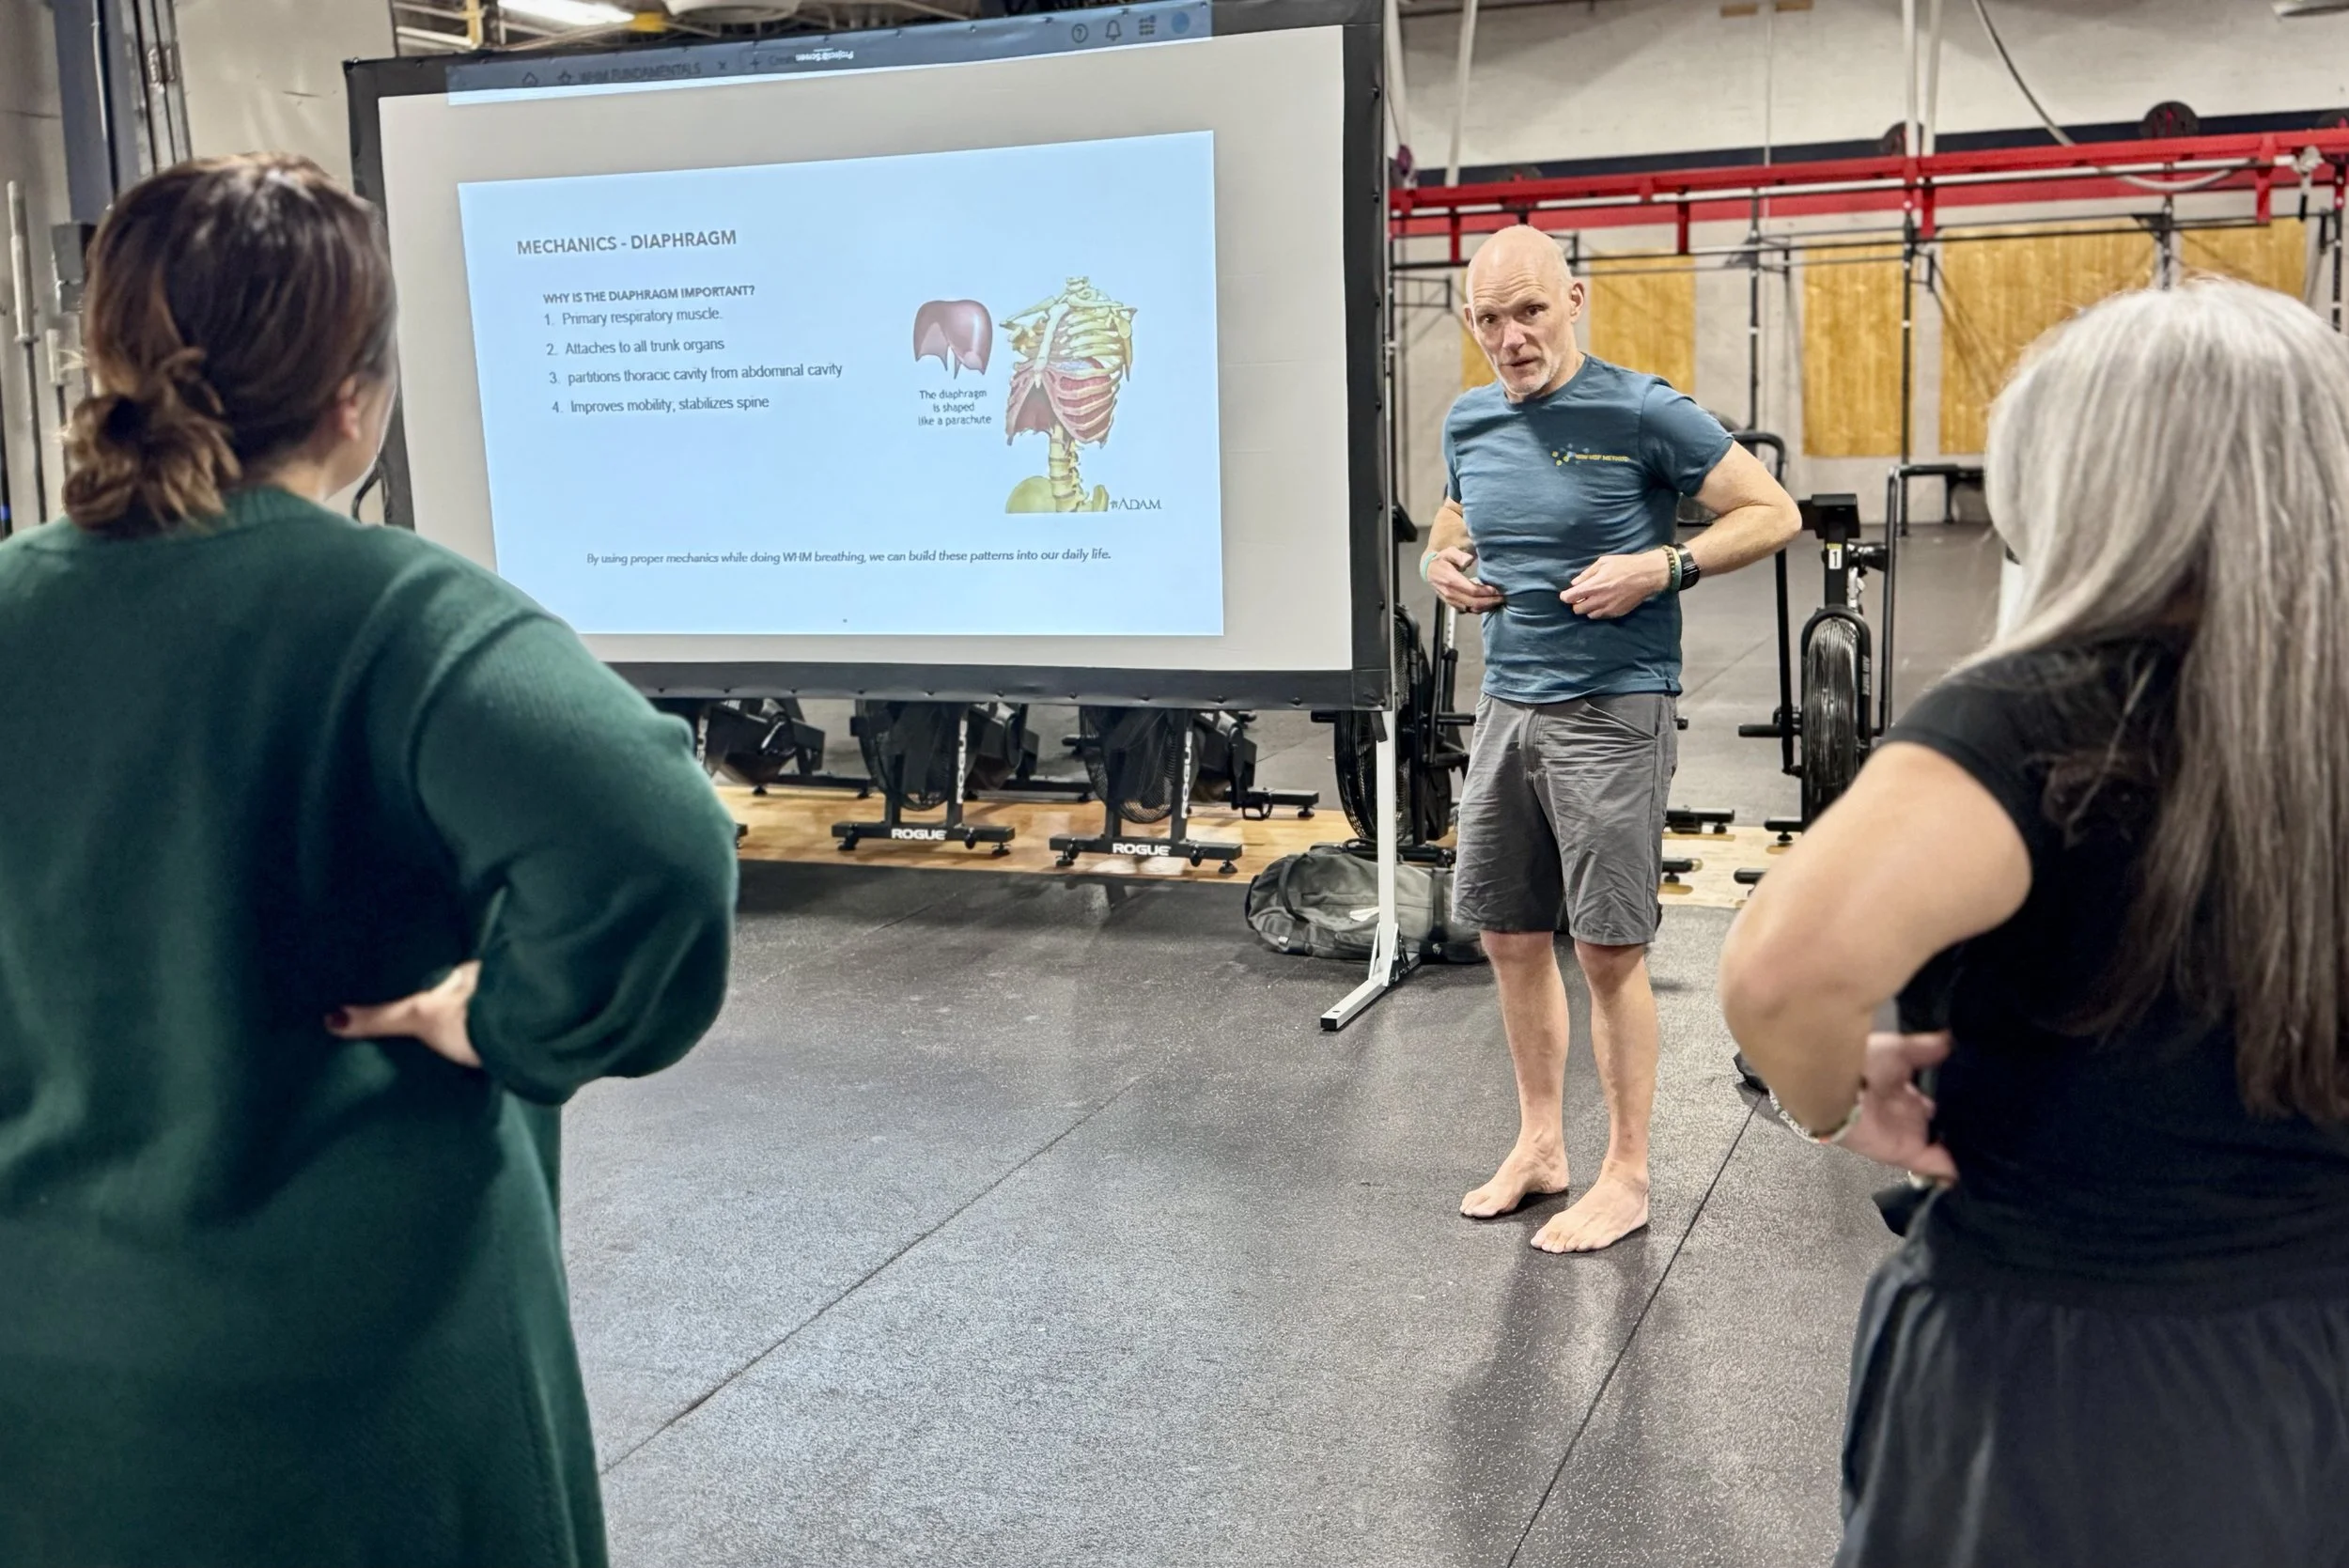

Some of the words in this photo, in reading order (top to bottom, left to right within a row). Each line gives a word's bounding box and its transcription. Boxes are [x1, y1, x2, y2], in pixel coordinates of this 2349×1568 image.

[517, 235, 617, 256] MECHANICS
[630, 229, 737, 250] DIAPHRAGM
[542, 292, 570, 304] WHY
[571, 292, 583, 303] IS
[583, 290, 607, 303] THE
[608, 287, 679, 302] DIAPHRAGM
[680, 285, 755, 299] IMPORTANT?
[562, 312, 608, 328] Primary
[610, 309, 674, 326] respiratory
[676, 306, 723, 321] muscle.
[545, 342, 558, 356] 2.
[565, 341, 616, 355] Attaches
[618, 340, 631, 354] to
[632, 339, 648, 353] all
[649, 338, 681, 353] trunk
[682, 339, 725, 354] organs
[568, 370, 622, 387] partitions
[623, 368, 671, 382] thoracic
[673, 366, 708, 383] cavity
[710, 365, 739, 380] from
[740, 363, 804, 379] abdominal
[806, 362, 843, 379] cavity
[918, 389, 938, 400] The
[938, 388, 988, 401] diaphragm
[570, 399, 625, 416] Improves
[677, 396, 735, 411] stabilizes
[736, 395, 770, 411] spine
[932, 402, 941, 413] is
[941, 400, 975, 414] shaped
[917, 414, 935, 427] like
[937, 416, 943, 426] a
[944, 414, 992, 427] parachute
[586, 552, 599, 567] By
[600, 553, 629, 567] using
[630, 554, 664, 567] proper
[665, 551, 720, 564] mechanics
[721, 551, 749, 563] while
[749, 551, 782, 566] doing
[782, 551, 813, 563] WHM
[814, 550, 867, 565] breathing,
[868, 553, 885, 562] we
[886, 553, 907, 562] can
[908, 549, 937, 562] build
[938, 549, 969, 562] these
[969, 551, 1015, 565] patterns
[1016, 549, 1039, 561] into
[1040, 551, 1060, 561] our
[1061, 548, 1090, 564] daily
[1091, 547, 1112, 560] life.
[1832, 551, 1838, 567] 1
[957, 719, 968, 804] ROGUE
[1181, 730, 1193, 819] ROGUE
[891, 828, 947, 840] ROGUE
[1112, 843, 1172, 856] ROGUE
